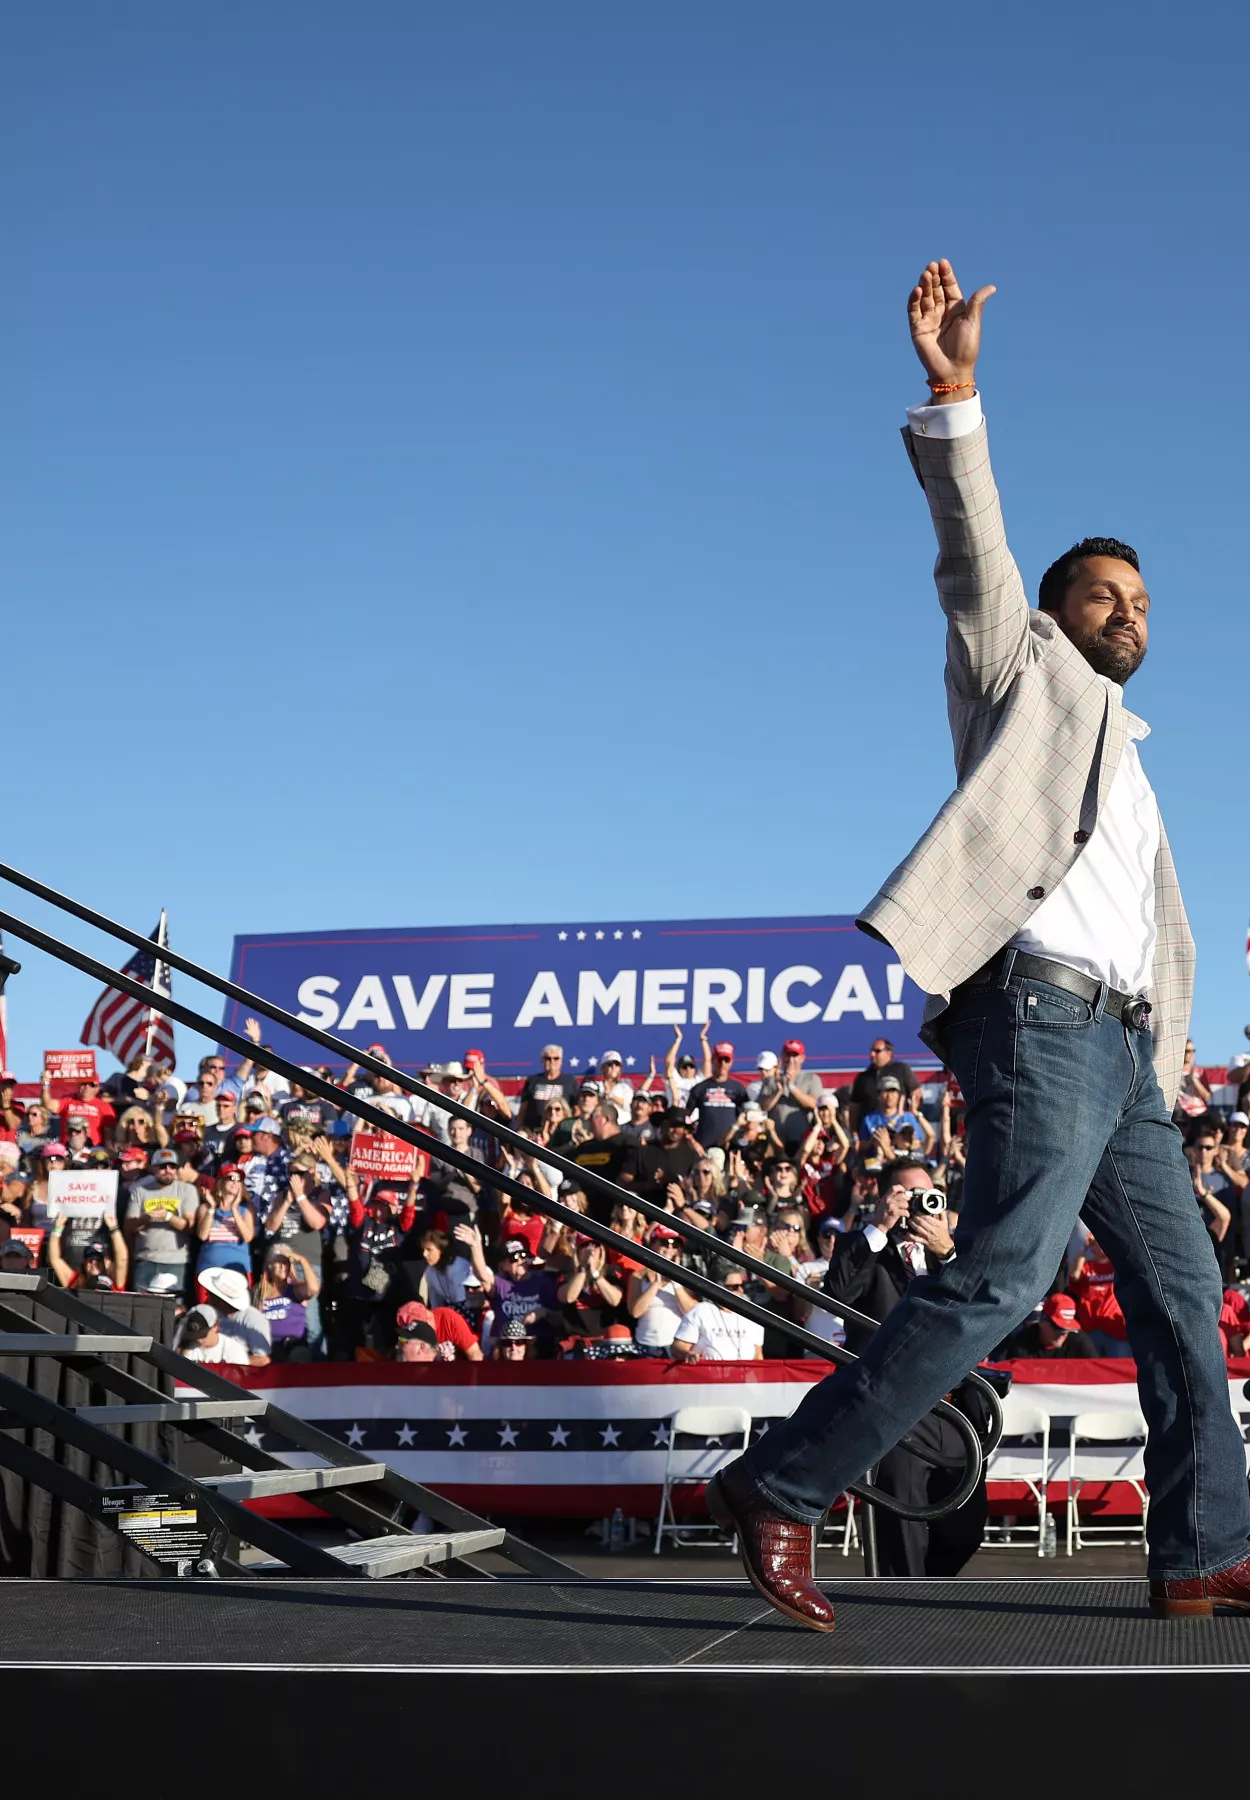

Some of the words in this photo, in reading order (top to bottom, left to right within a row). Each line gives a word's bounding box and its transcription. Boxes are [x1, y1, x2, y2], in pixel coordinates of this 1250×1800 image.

[296, 973, 495, 1030] SAVE
[513, 963, 905, 1028] AMERICA!
[373, 1141, 395, 1150] MAKE
[352, 1148, 414, 1163] AMERICA
[352, 1160, 382, 1171] PROUD
[383, 1163, 413, 1173] AGAIN
[67, 1183, 97, 1191] SAVE
[54, 1195, 109, 1204] AMERICA!
